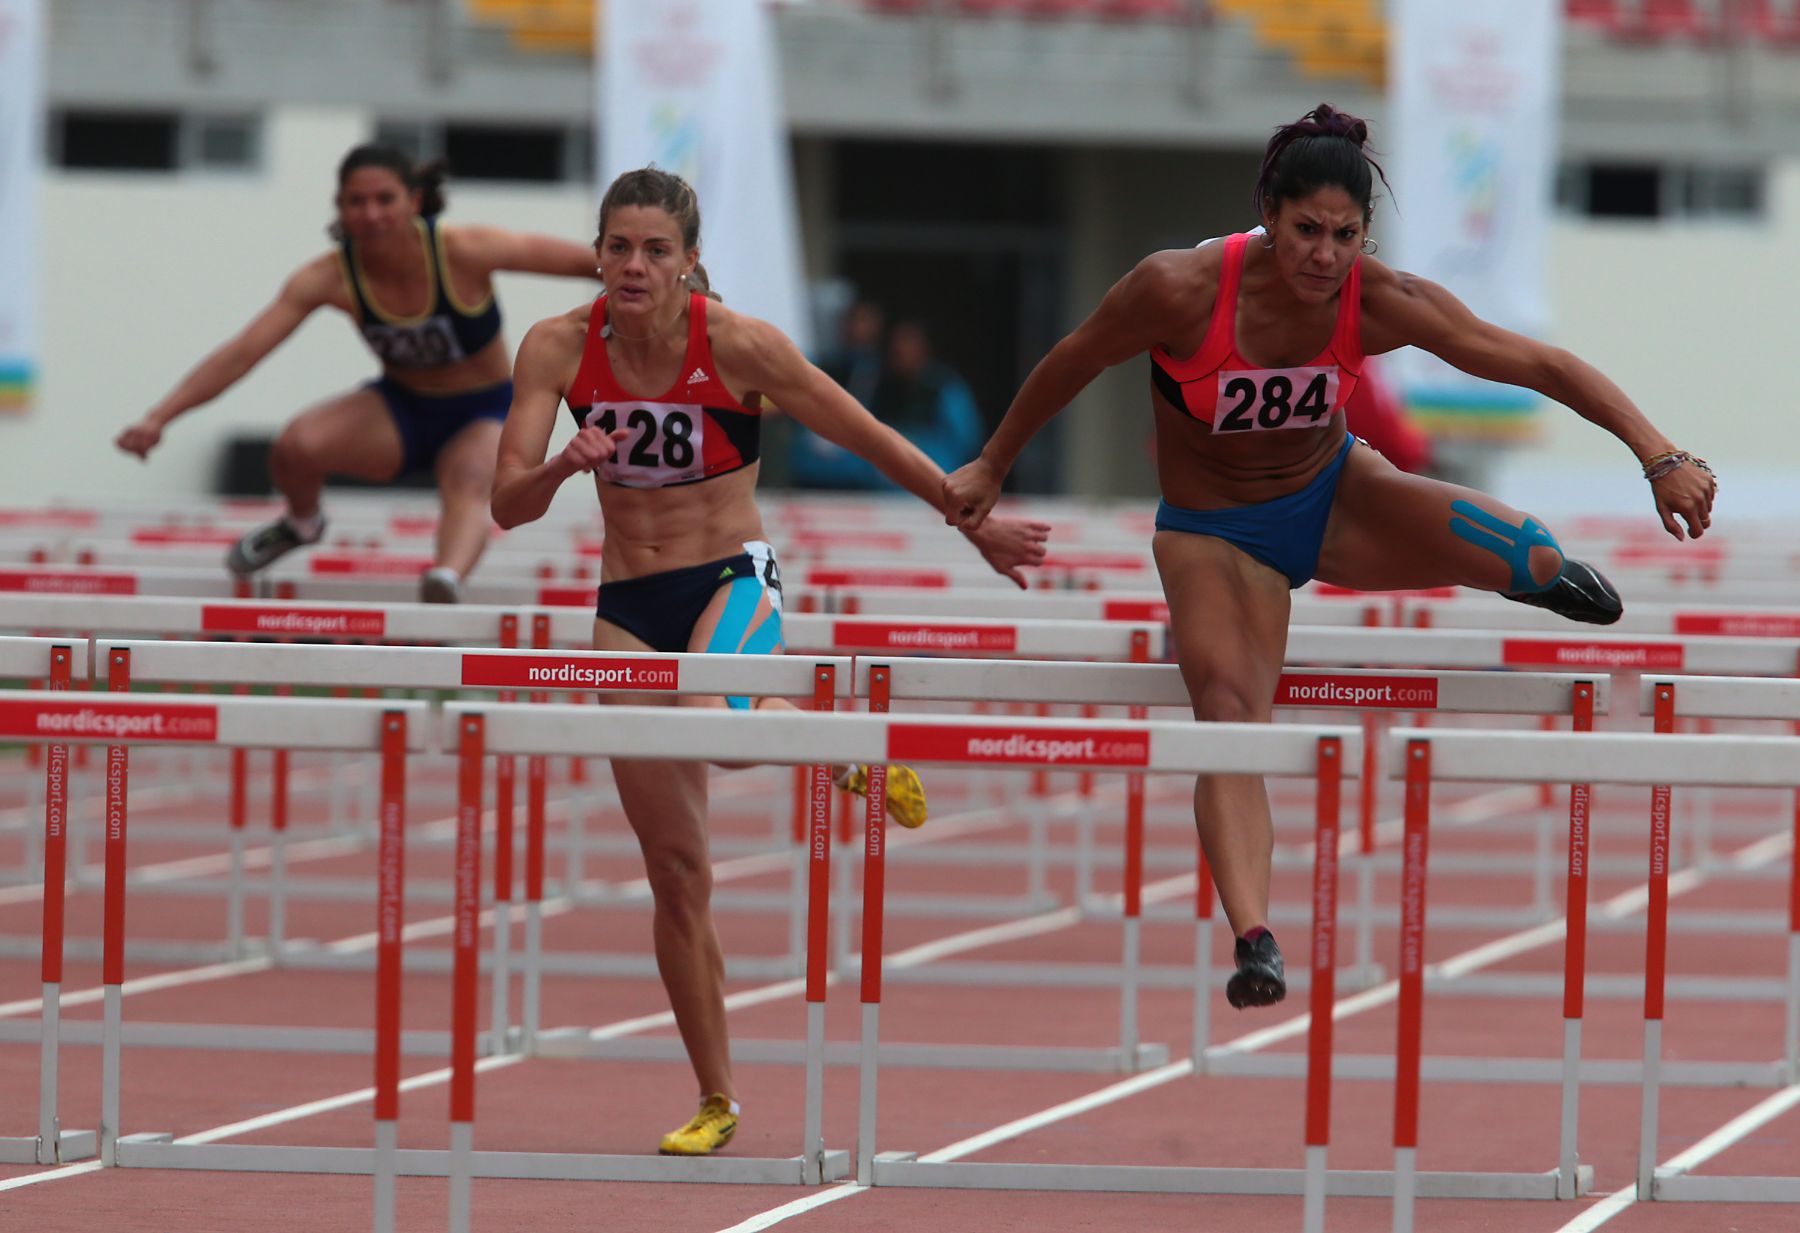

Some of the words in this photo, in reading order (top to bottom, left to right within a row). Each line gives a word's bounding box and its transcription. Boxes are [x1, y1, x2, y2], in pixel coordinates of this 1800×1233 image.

[1218, 373, 1329, 431] 284
[594, 409, 695, 468] 128
[257, 613, 384, 632] nordicsport.com
[528, 663, 674, 685] nordicsport.com
[1289, 682, 1433, 704] nordicsport.com
[36, 711, 213, 737] nordicsport.com
[967, 734, 1145, 761] nordicsport.com
[49, 744, 66, 836] dicsport.com
[109, 744, 125, 839] rdicsport.com
[812, 764, 830, 860] rdicsport.com
[868, 764, 885, 856] dicsport.com
[1571, 784, 1589, 877] dicsport.com
[1652, 784, 1670, 874] dicsport.com
